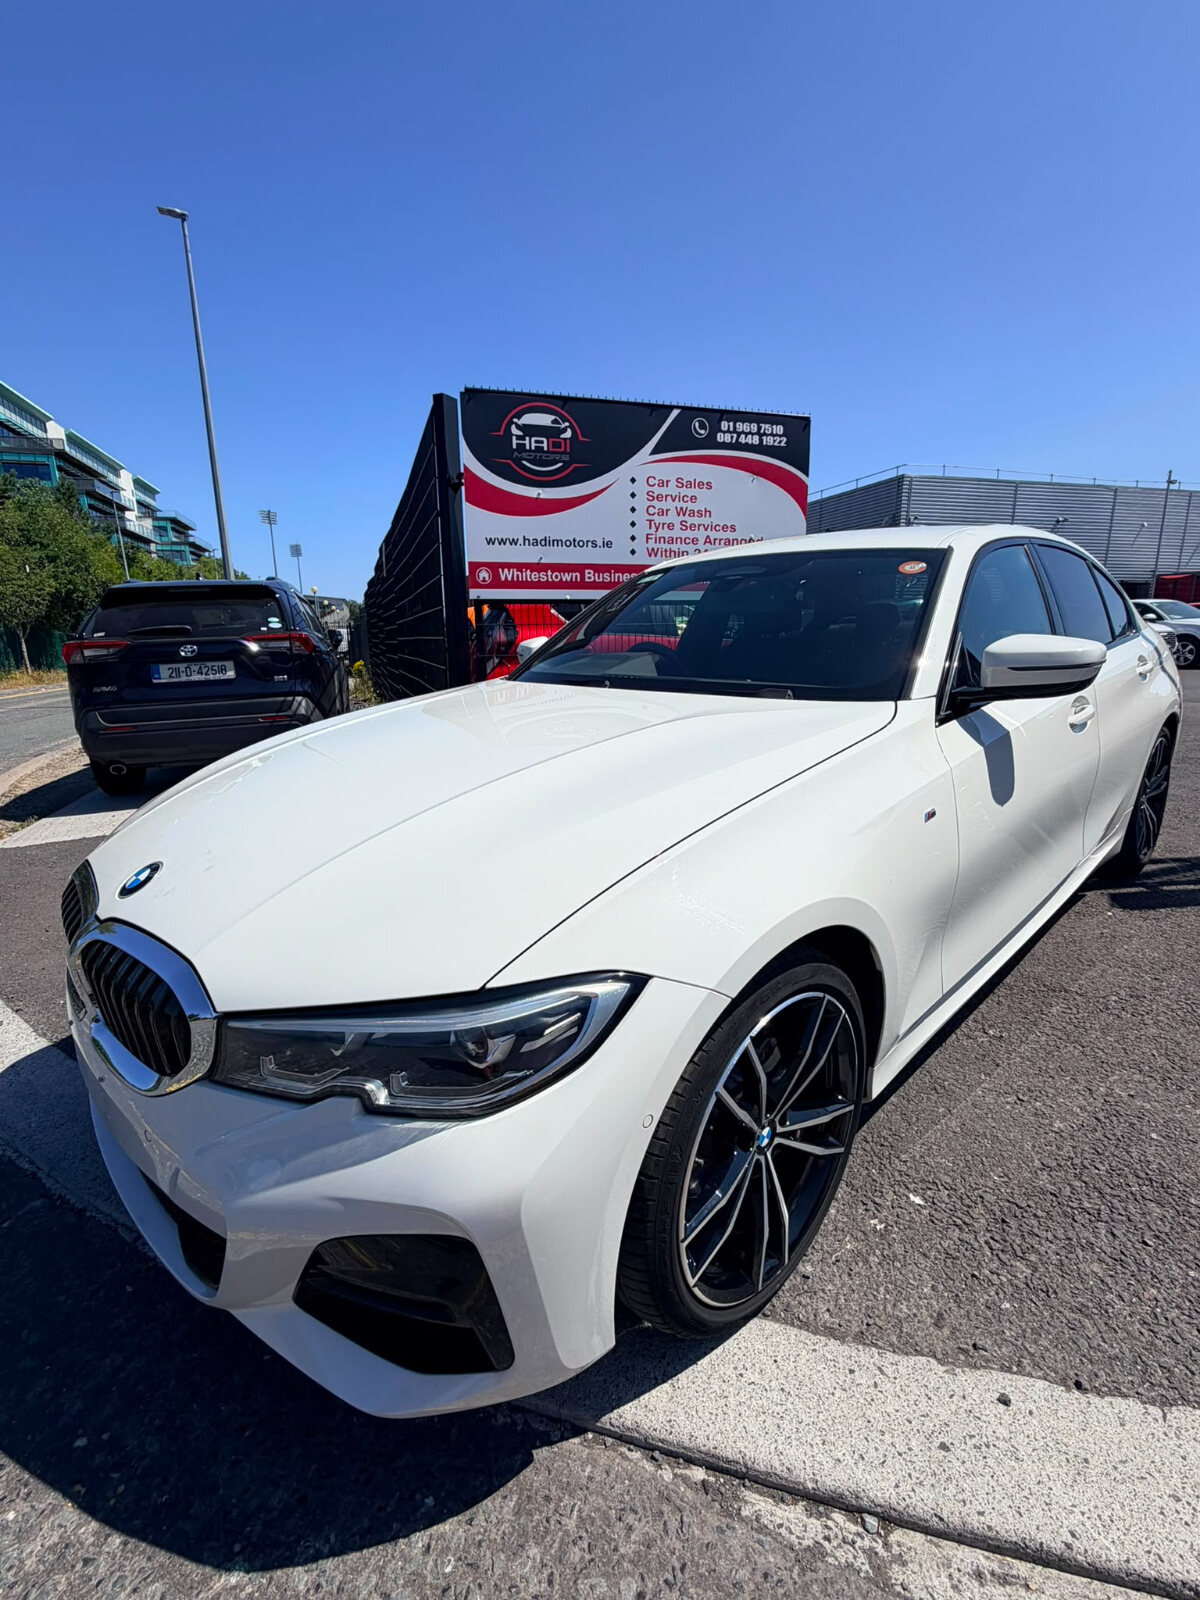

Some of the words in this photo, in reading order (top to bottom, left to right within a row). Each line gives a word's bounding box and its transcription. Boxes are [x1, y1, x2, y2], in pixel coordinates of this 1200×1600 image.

[721, 420, 733, 431] 01
[736, 421, 758, 433] 969
[759, 423, 784, 435] 7510
[512, 435, 570, 453] HADI
[716, 432, 737, 443] 087
[738, 433, 759, 445] 448
[762, 436, 787, 446] 1922
[512, 452, 570, 461] MOTORS
[645, 476, 671, 488] Car
[675, 477, 713, 490] Sales
[646, 490, 698, 503] Service
[645, 505, 671, 517] Car
[675, 506, 712, 518] Wash
[646, 519, 675, 533] Tyre
[679, 520, 737, 533] Services
[485, 535, 613, 549] www.hadimotors.ie
[645, 533, 699, 546] Finance
[646, 547, 689, 559] Within
[499, 567, 580, 583] Whitestown
[168, 664, 227, 679] 211-D-42518
